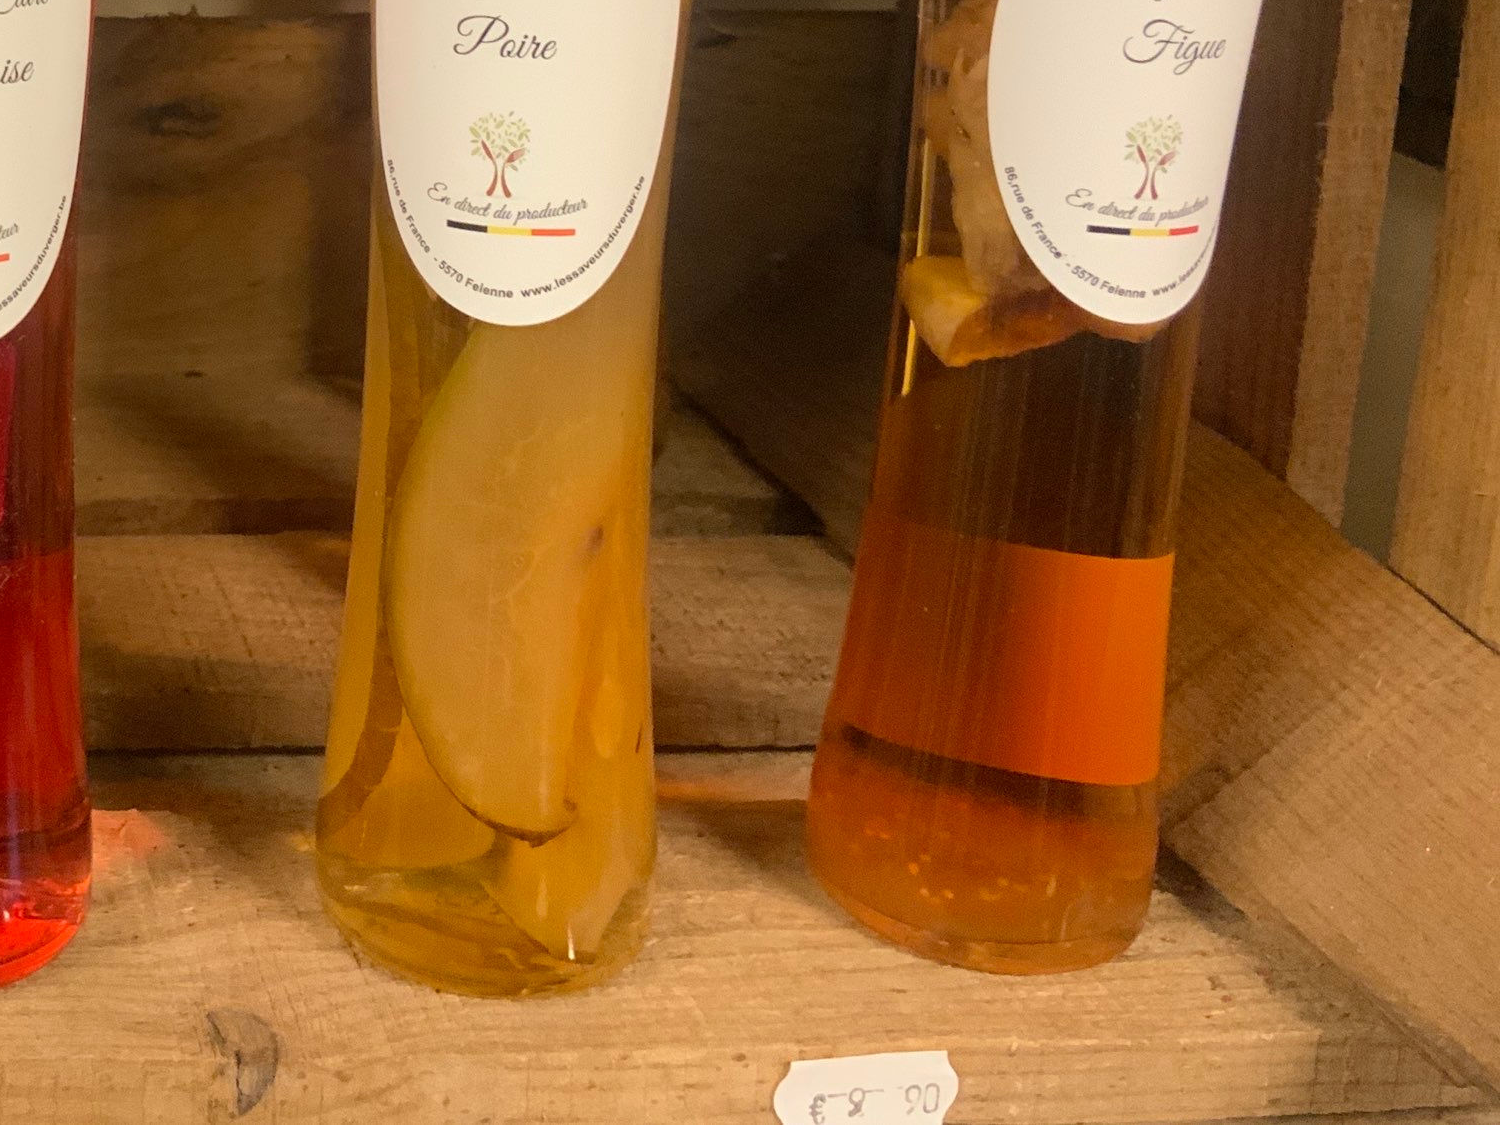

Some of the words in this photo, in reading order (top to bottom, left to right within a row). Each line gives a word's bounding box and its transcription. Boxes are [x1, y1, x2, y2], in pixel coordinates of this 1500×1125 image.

[453, 15, 556, 61] Poire
[1123, 19, 1226, 75] Figue
[427, 182, 450, 205] En
[454, 197, 491, 217] direct
[493, 205, 512, 219] du
[512, 196, 588, 225] producteur
[1066, 189, 1094, 210] En
[1098, 202, 1138, 219] direct
[1138, 206, 1155, 221] du
[400, 199, 408, 213] de
[406, 215, 430, 253] France
[439, 261, 464, 283] 5570
[1022, 205, 1034, 221] de
[1031, 222, 1062, 259] France
[1071, 266, 1099, 287] 5570
